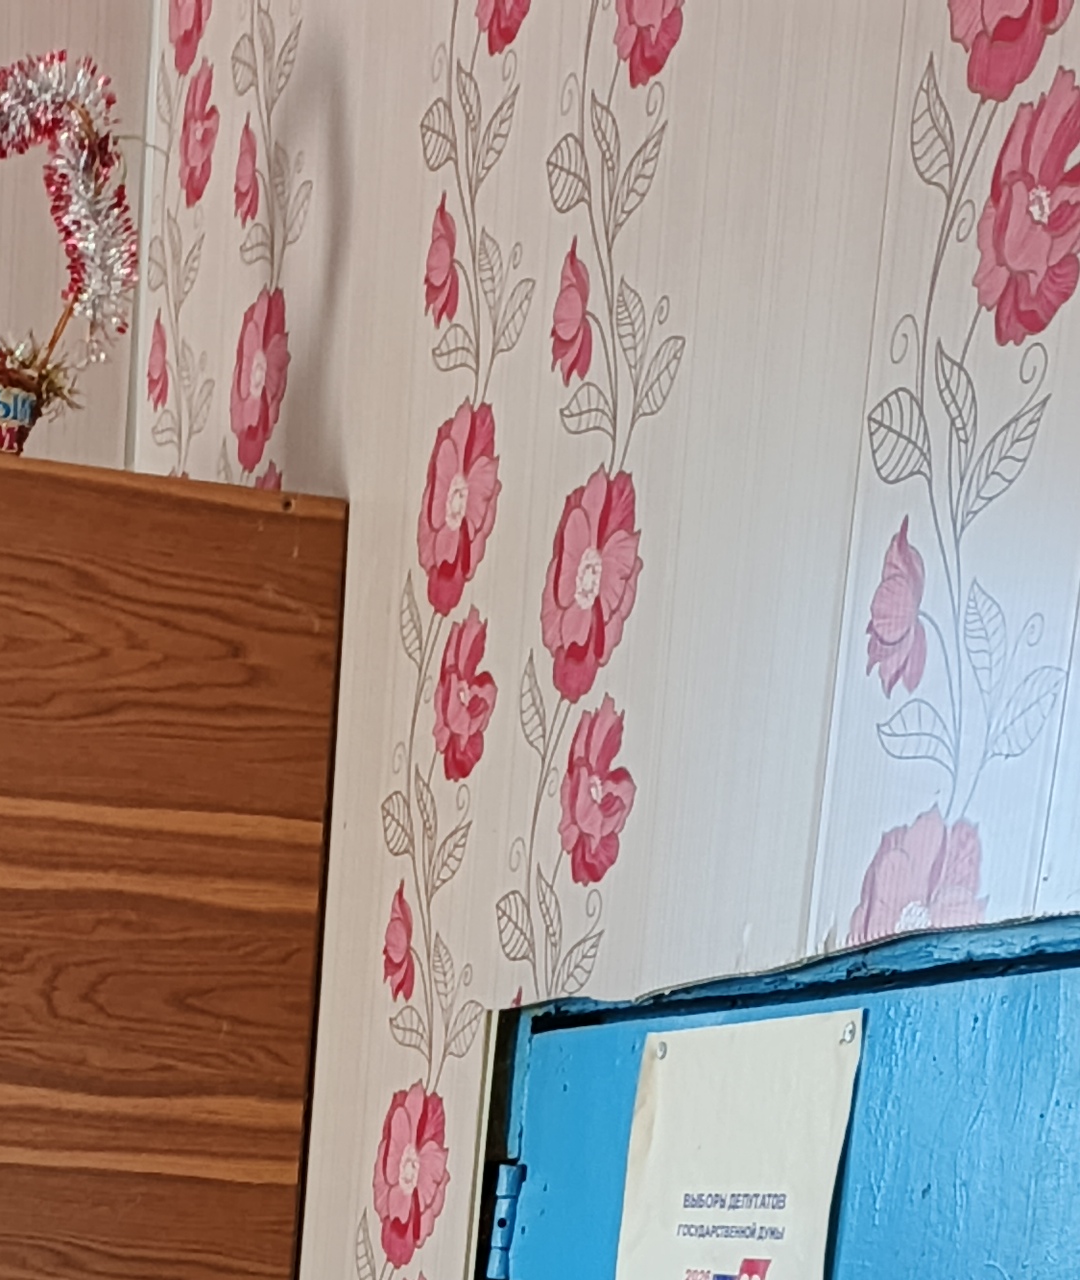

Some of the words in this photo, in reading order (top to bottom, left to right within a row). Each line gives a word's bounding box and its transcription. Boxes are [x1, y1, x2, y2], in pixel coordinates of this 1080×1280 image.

[683, 1193, 727, 1209] ВЫБОРЫ
[728, 1193, 787, 1211] ДЕПУТАТОВ
[677, 1222, 757, 1239] ГОСУДАРСТВЕННОЙ
[756, 1226, 785, 1241] ДУМЫ
